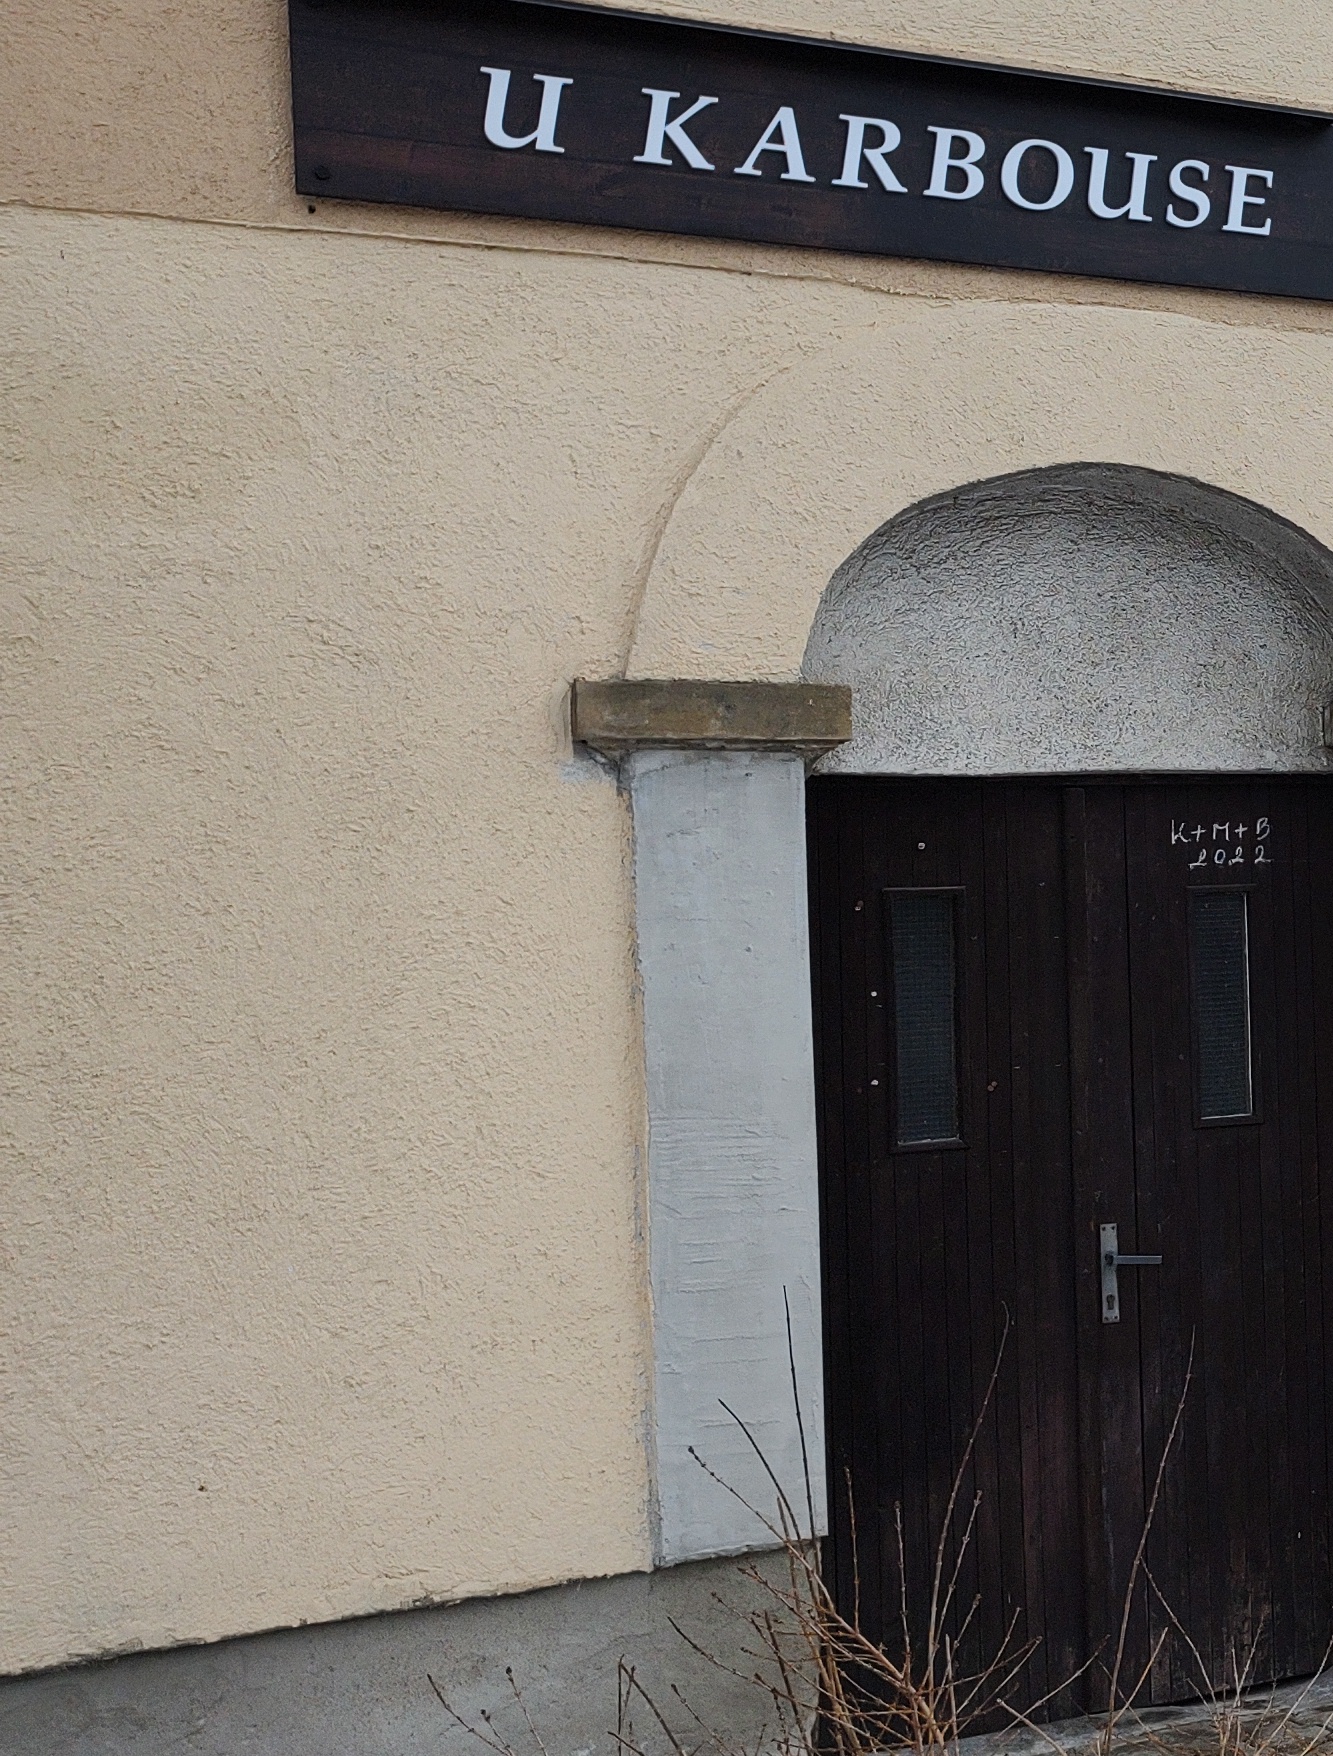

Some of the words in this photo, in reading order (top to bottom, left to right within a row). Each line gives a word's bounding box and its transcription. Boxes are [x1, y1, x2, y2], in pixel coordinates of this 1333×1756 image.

[480, 66, 574, 154] U
[633, 88, 1275, 238] KARBOUSE
[1188, 845, 1273, 871] 2022
